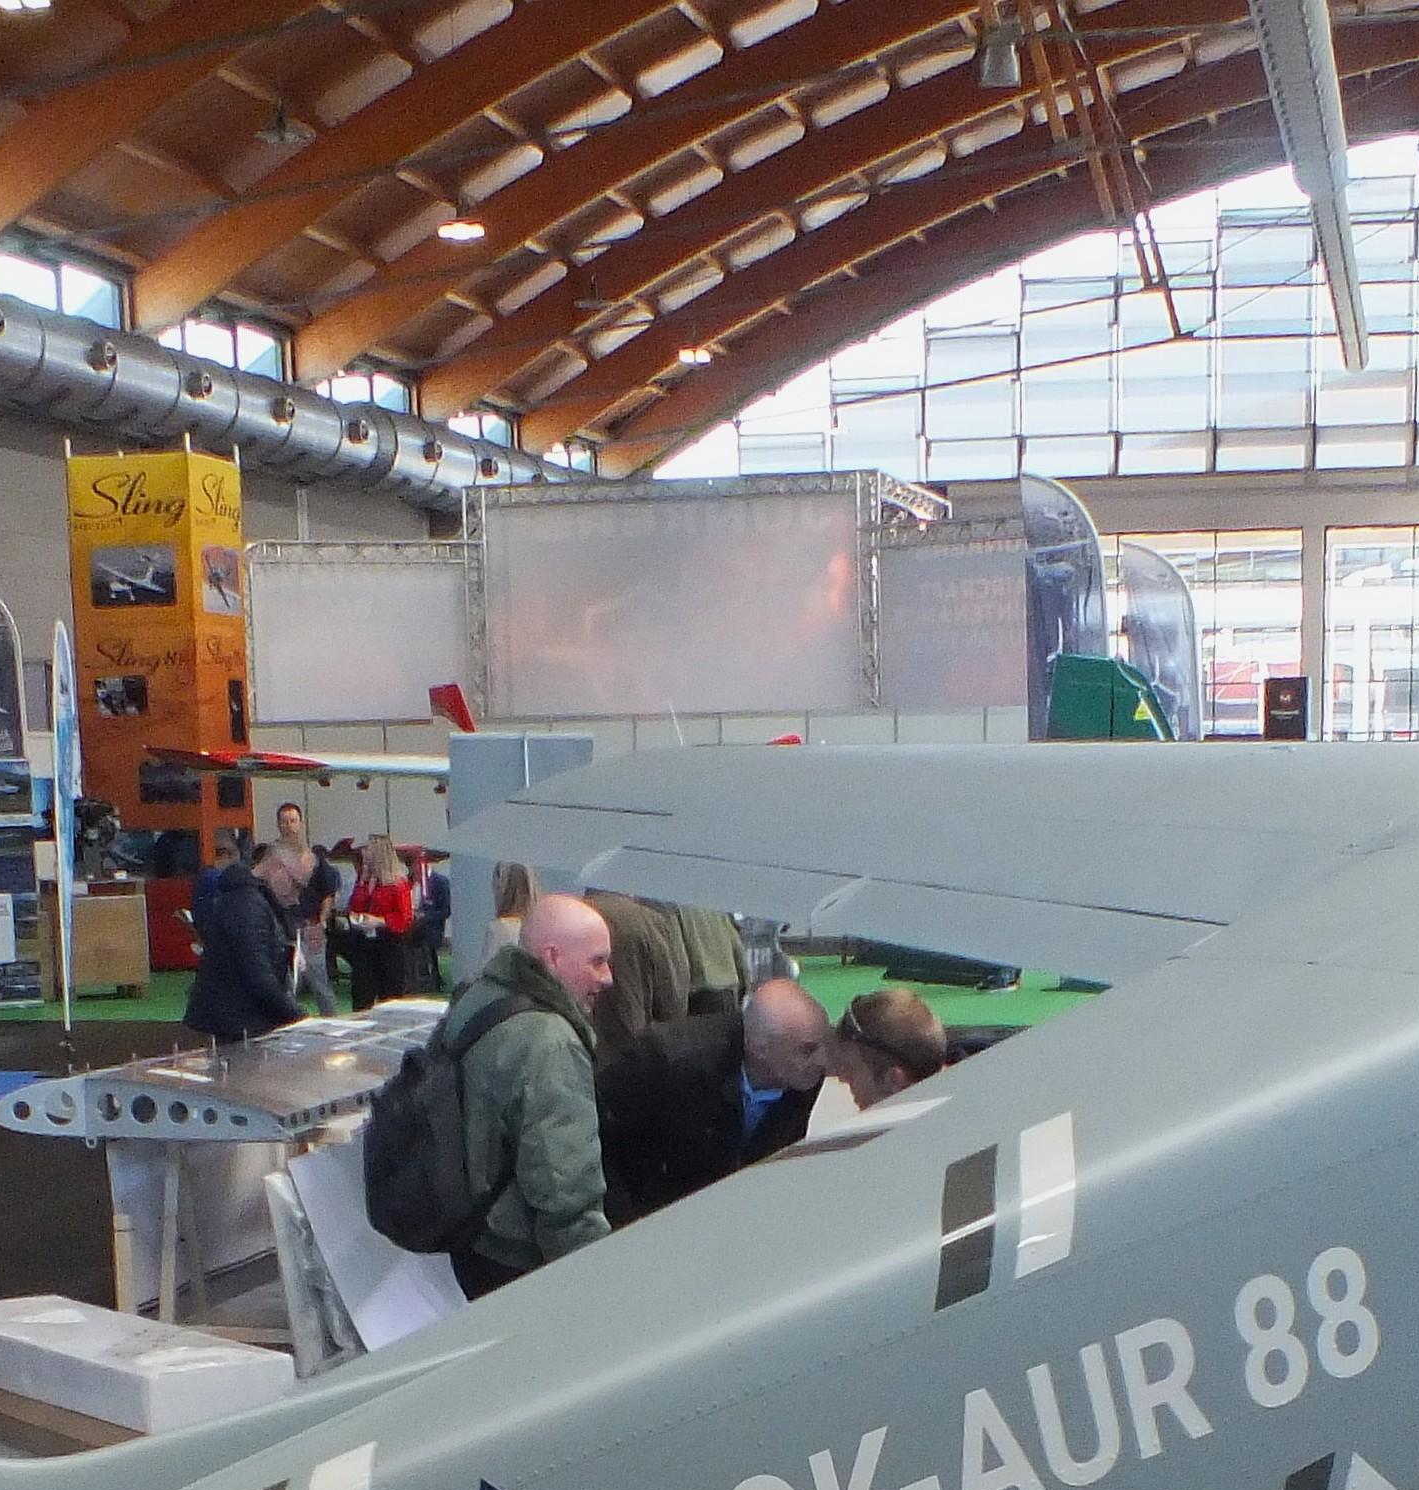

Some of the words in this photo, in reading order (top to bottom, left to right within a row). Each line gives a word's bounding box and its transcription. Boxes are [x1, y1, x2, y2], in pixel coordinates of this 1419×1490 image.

[73, 471, 185, 528] Sling
[196, 473, 241, 533] Sling
[1234, 1247, 1378, 1408] 88
